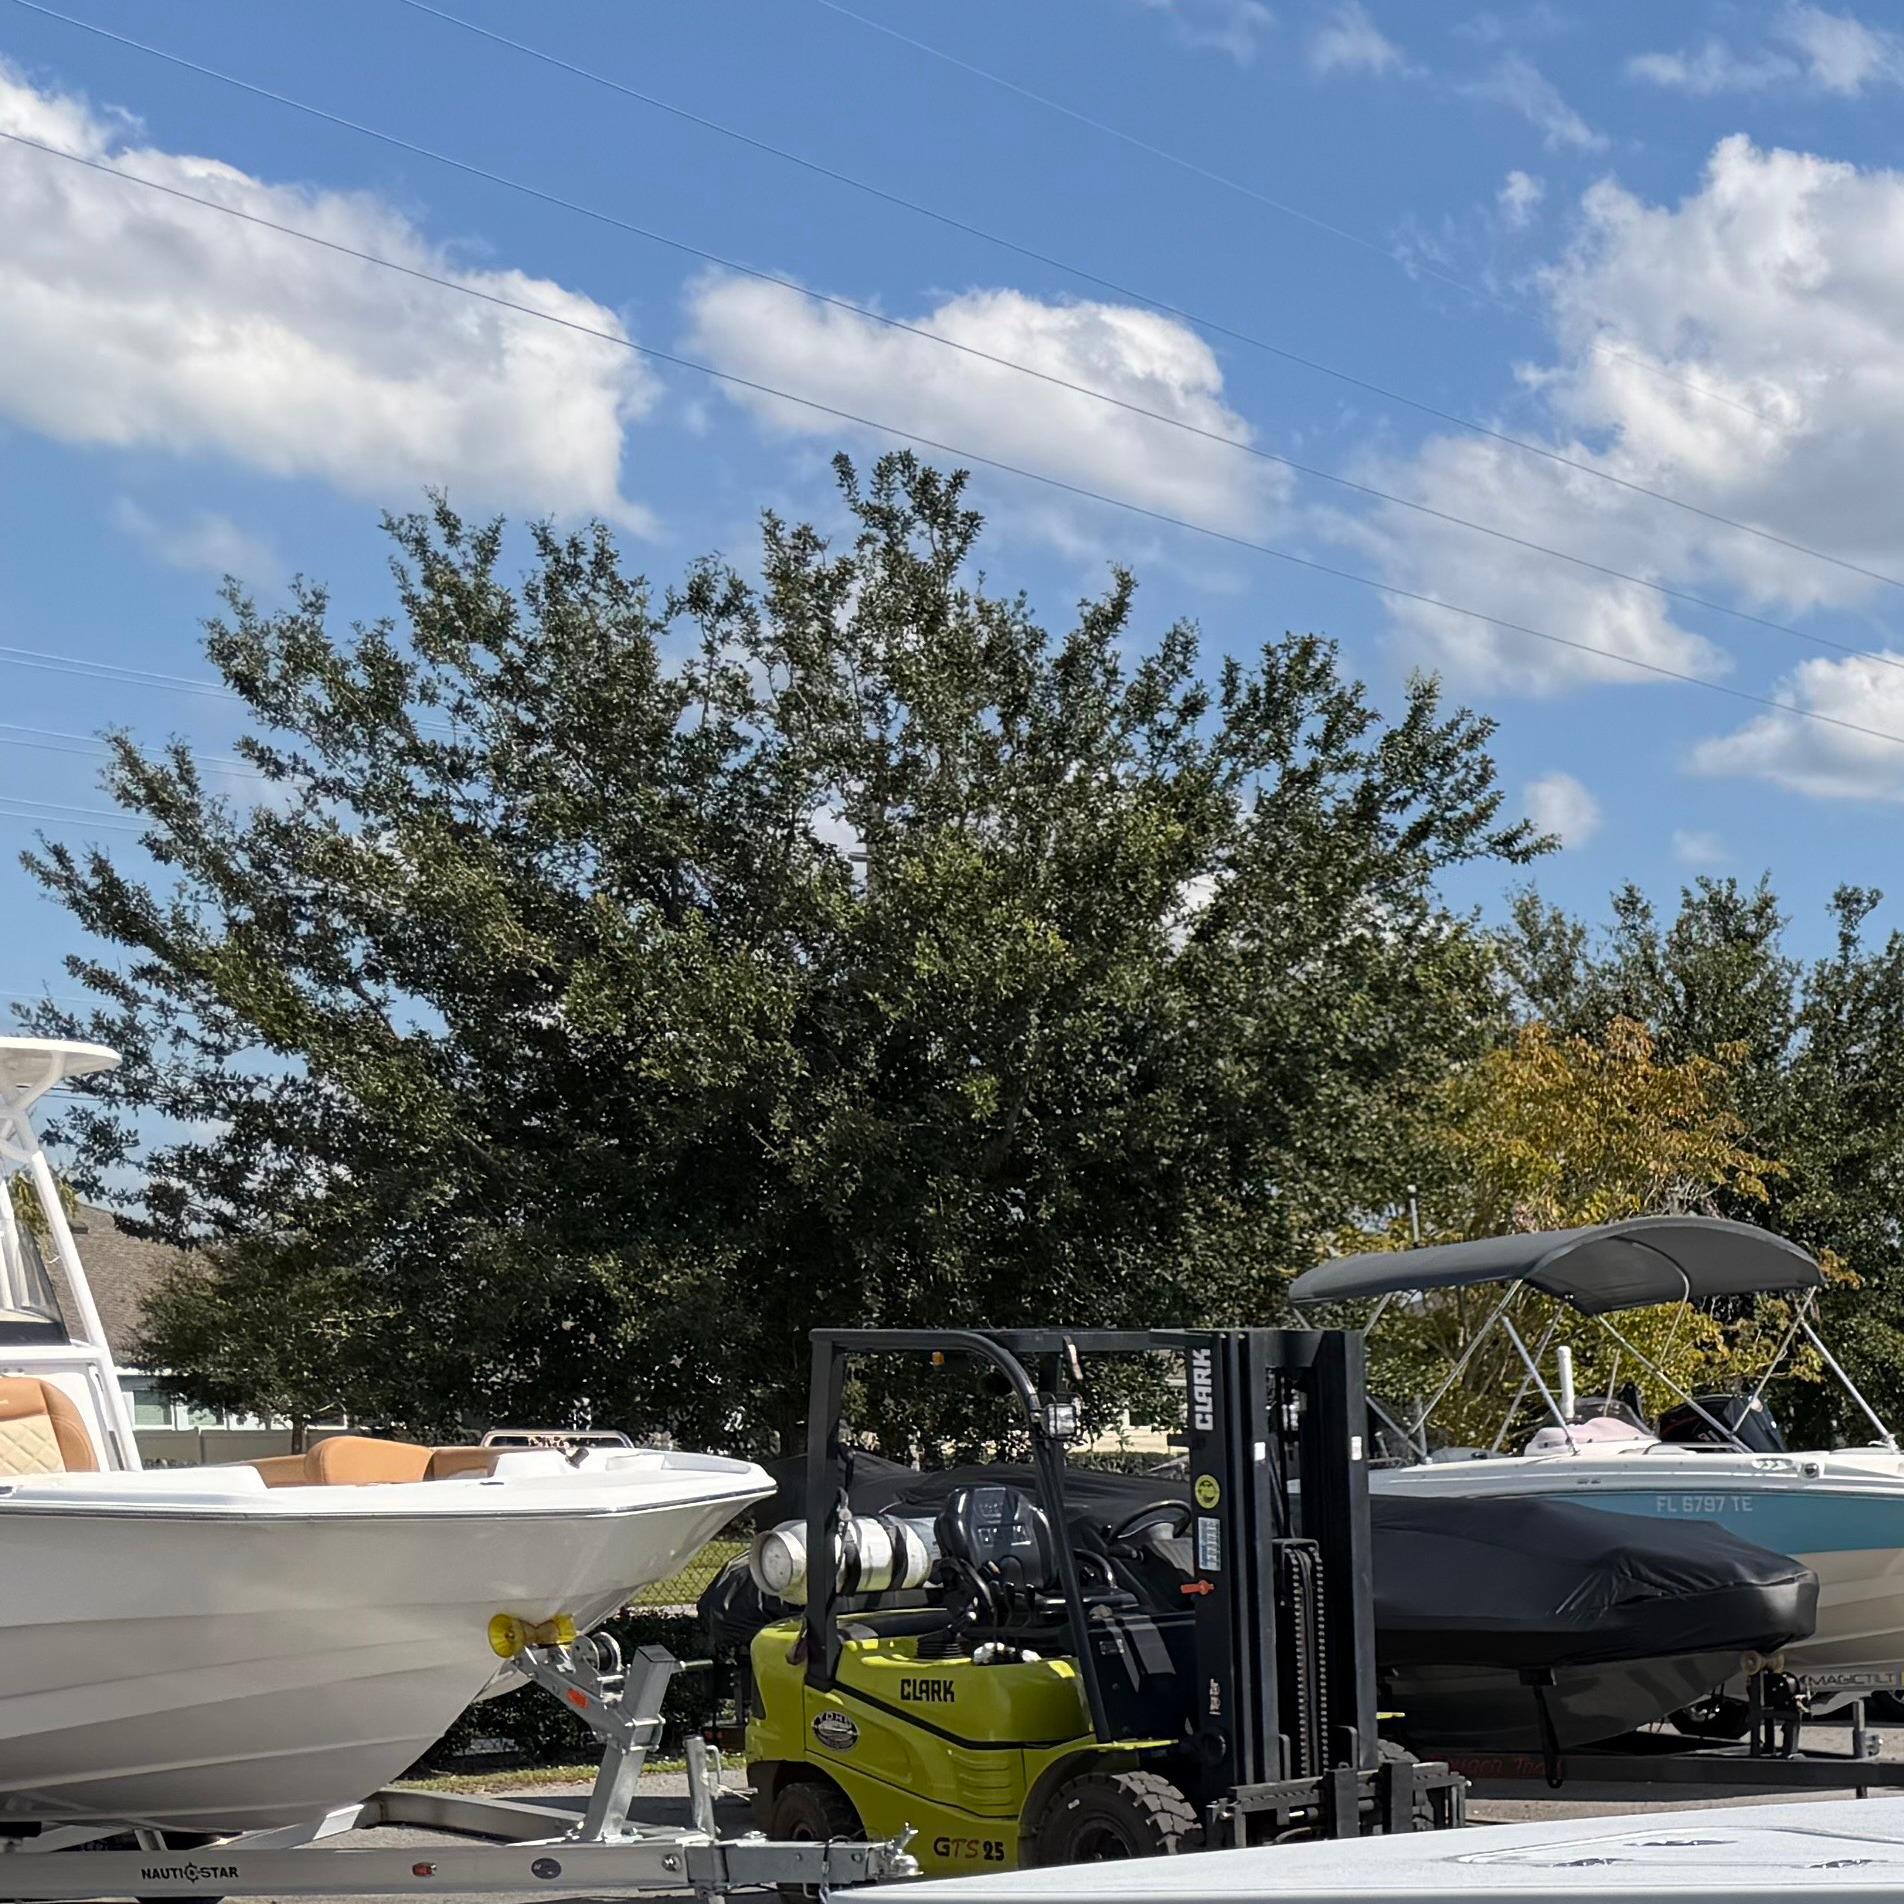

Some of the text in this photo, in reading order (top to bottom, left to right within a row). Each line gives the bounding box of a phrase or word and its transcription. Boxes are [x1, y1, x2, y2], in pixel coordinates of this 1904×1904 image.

[1192, 1348, 1214, 1431] CLARK
[1656, 1495, 1753, 1513] FL 6797 TE
[900, 1678, 956, 1703] CLARK
[933, 1836, 1005, 1862] GTS 25
